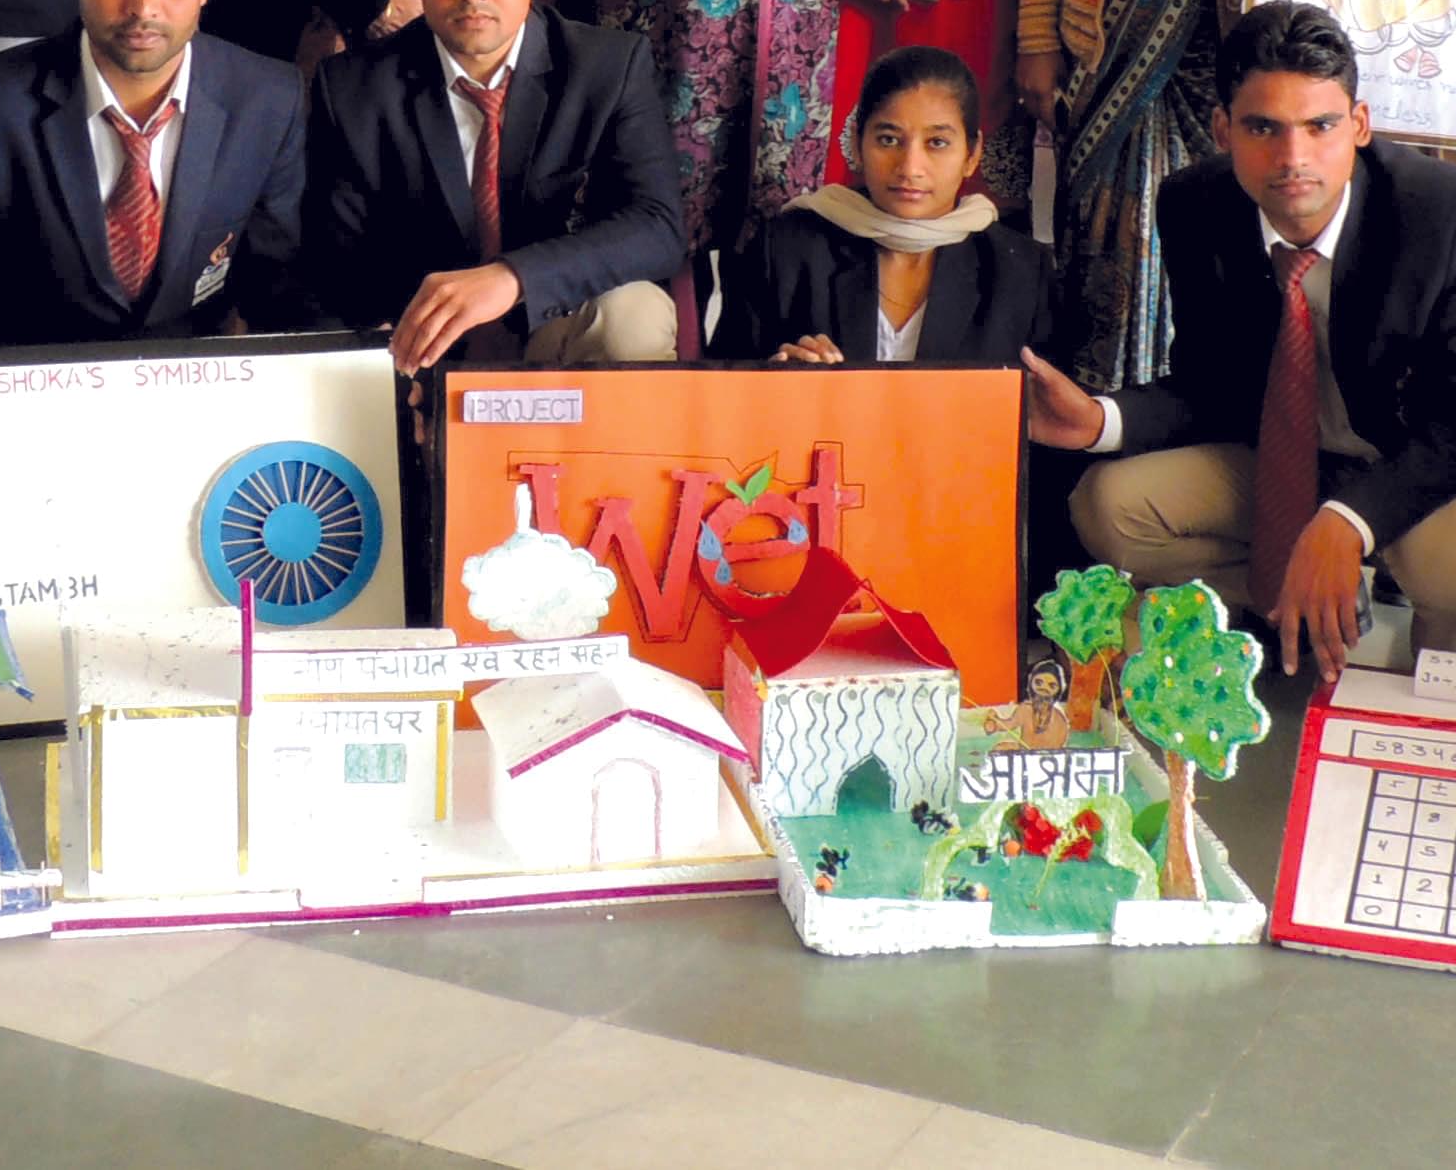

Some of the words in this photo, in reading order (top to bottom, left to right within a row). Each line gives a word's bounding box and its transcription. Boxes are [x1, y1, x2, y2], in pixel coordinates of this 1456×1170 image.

[134, 360, 255, 388] SYMBOLS
[469, 395, 581, 422] PROJECT
[513, 647, 560, 672] रहन
[960, 746, 1134, 802] आश्रम
[1416, 878, 1433, 893] 2
